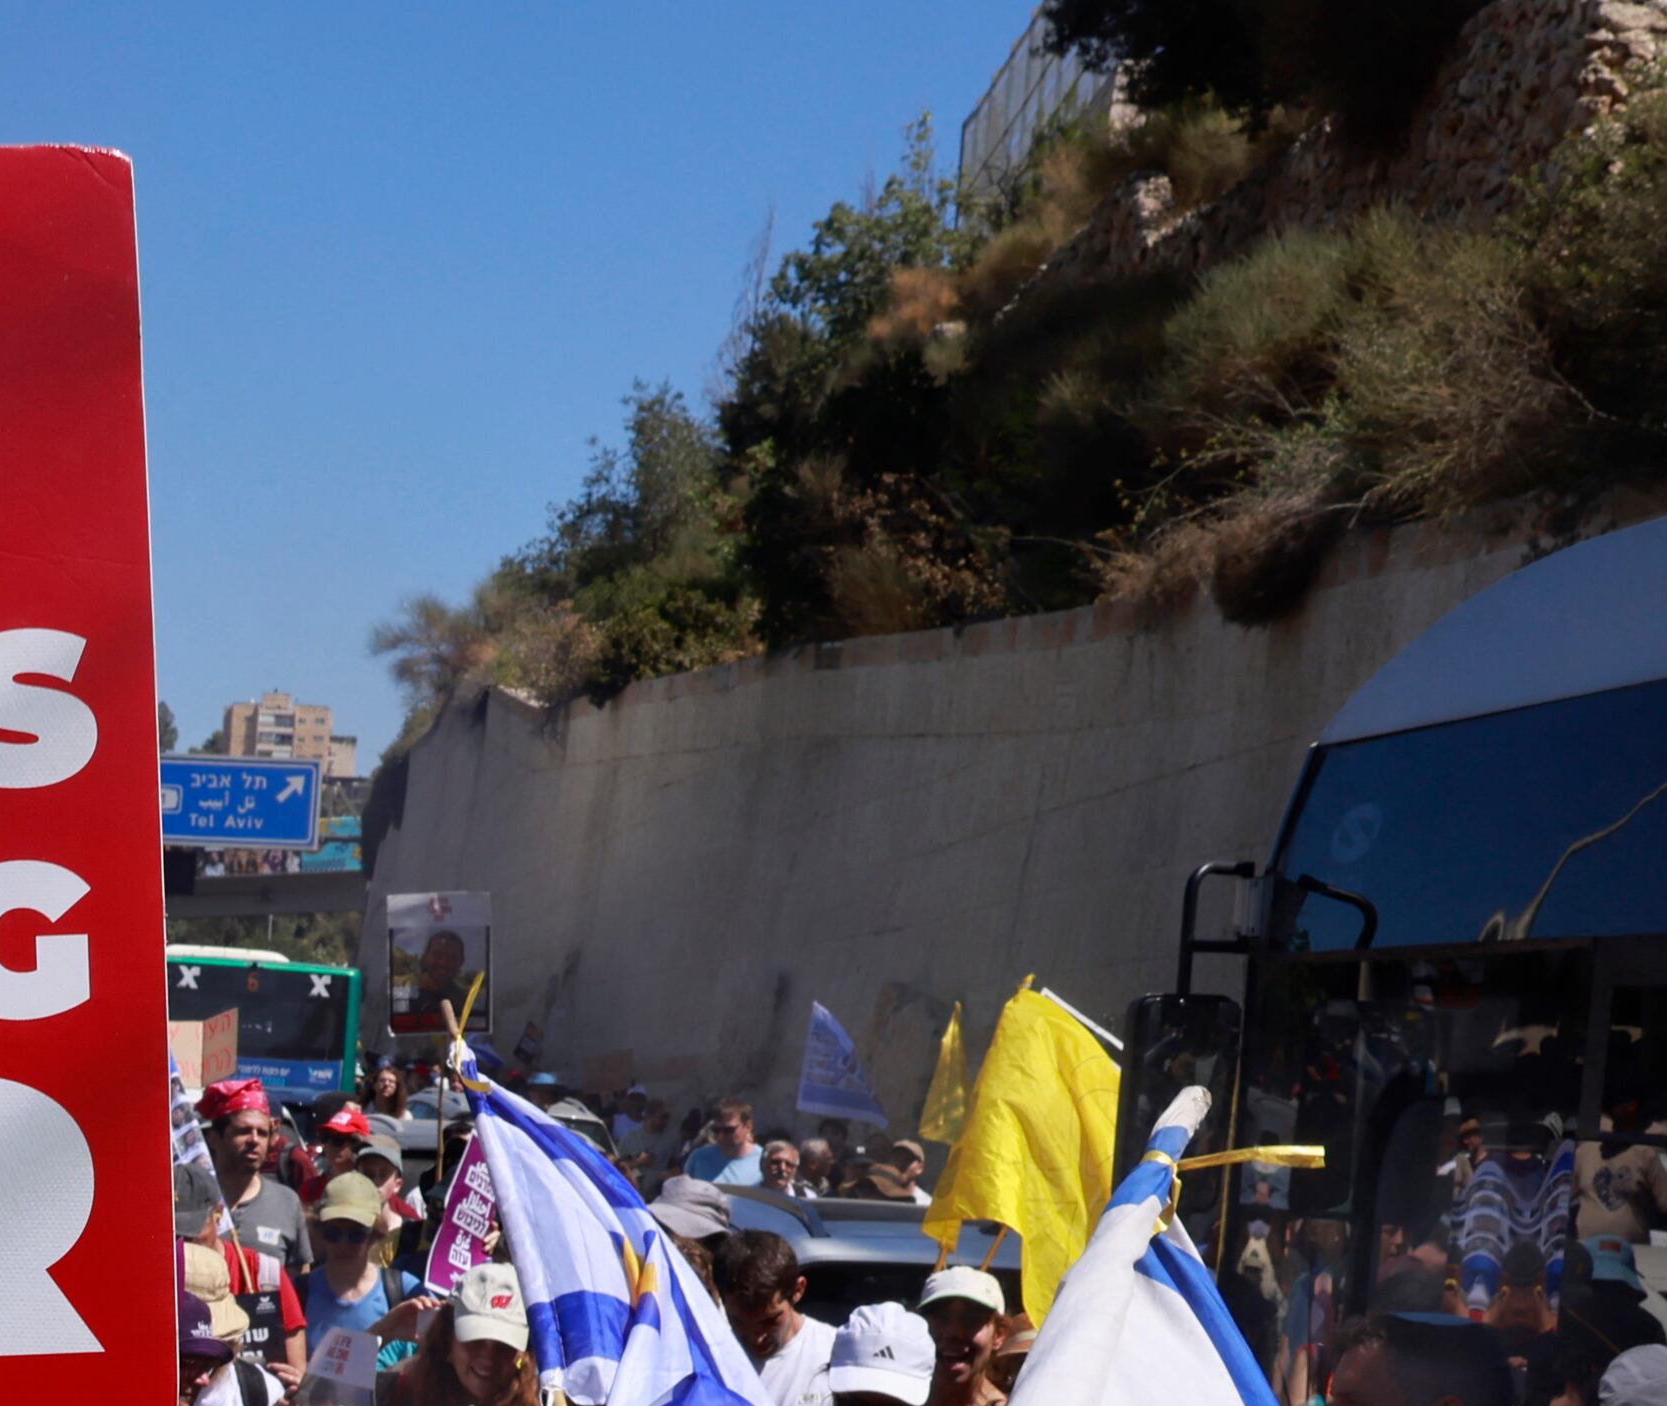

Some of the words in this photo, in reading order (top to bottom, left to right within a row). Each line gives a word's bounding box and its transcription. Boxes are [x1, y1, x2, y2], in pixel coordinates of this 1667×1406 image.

[190, 773, 231, 789] אביב
[241, 772, 269, 790] תל
[188, 813, 214, 828] Tel
[224, 815, 265, 830] Aviv
